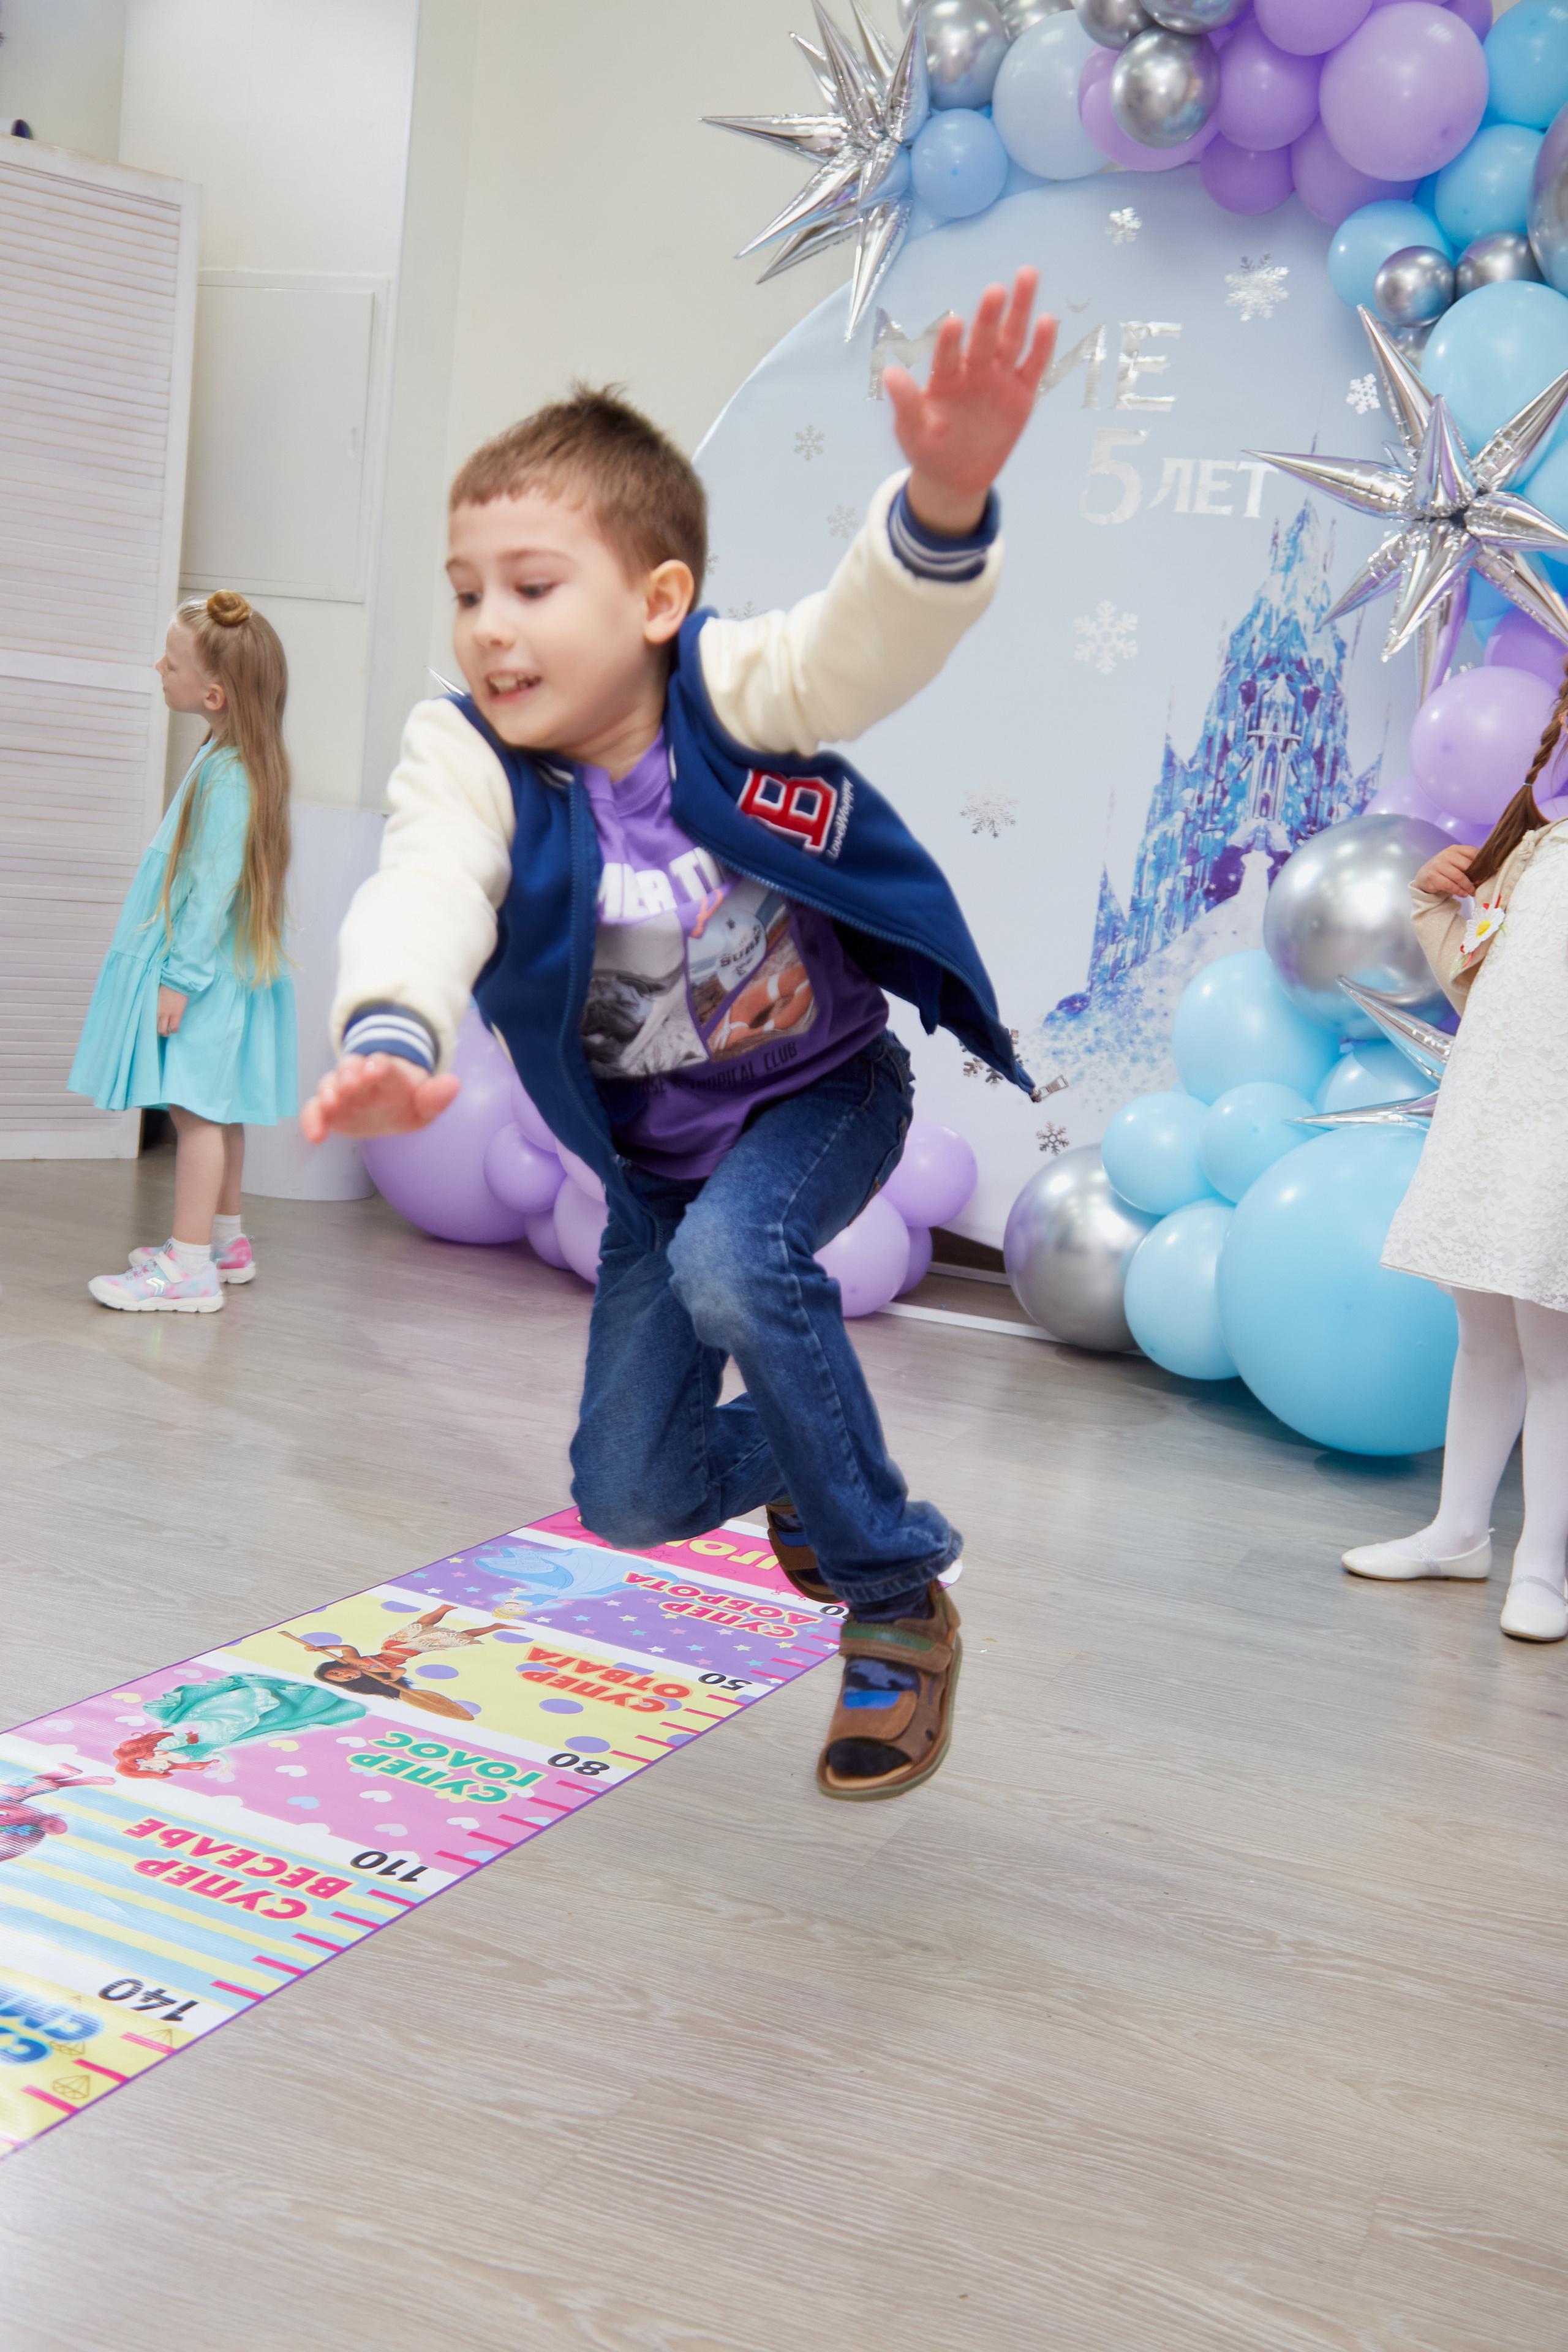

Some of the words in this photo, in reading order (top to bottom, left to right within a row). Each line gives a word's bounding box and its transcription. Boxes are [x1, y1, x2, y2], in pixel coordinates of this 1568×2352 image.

[864, 296, 1182, 412] МЙЕ
[1077, 428, 1150, 526] 5
[1147, 456, 1279, 519] ЛЕТ
[738, 767, 837, 854] B
[764, 1041, 798, 1071] CLUB
[624, 1571, 819, 1626] ДОБРОТА
[662, 1602, 796, 1638] СУПЕР
[521, 1671, 666, 1713] СУПЕР
[525, 1647, 691, 1699] ОТВАГА
[698, 1673, 753, 1692] 50
[350, 1752, 508, 1803] СУПЕР
[372, 1732, 544, 1788] ГОЛОС
[547, 1752, 610, 1776] 80
[123, 1818, 353, 1900] ВЕСЕЛЬЕ
[349, 1850, 429, 1883] 110
[134, 1858, 307, 1920] СУПЕР
[98, 1978, 200, 2022] 140
